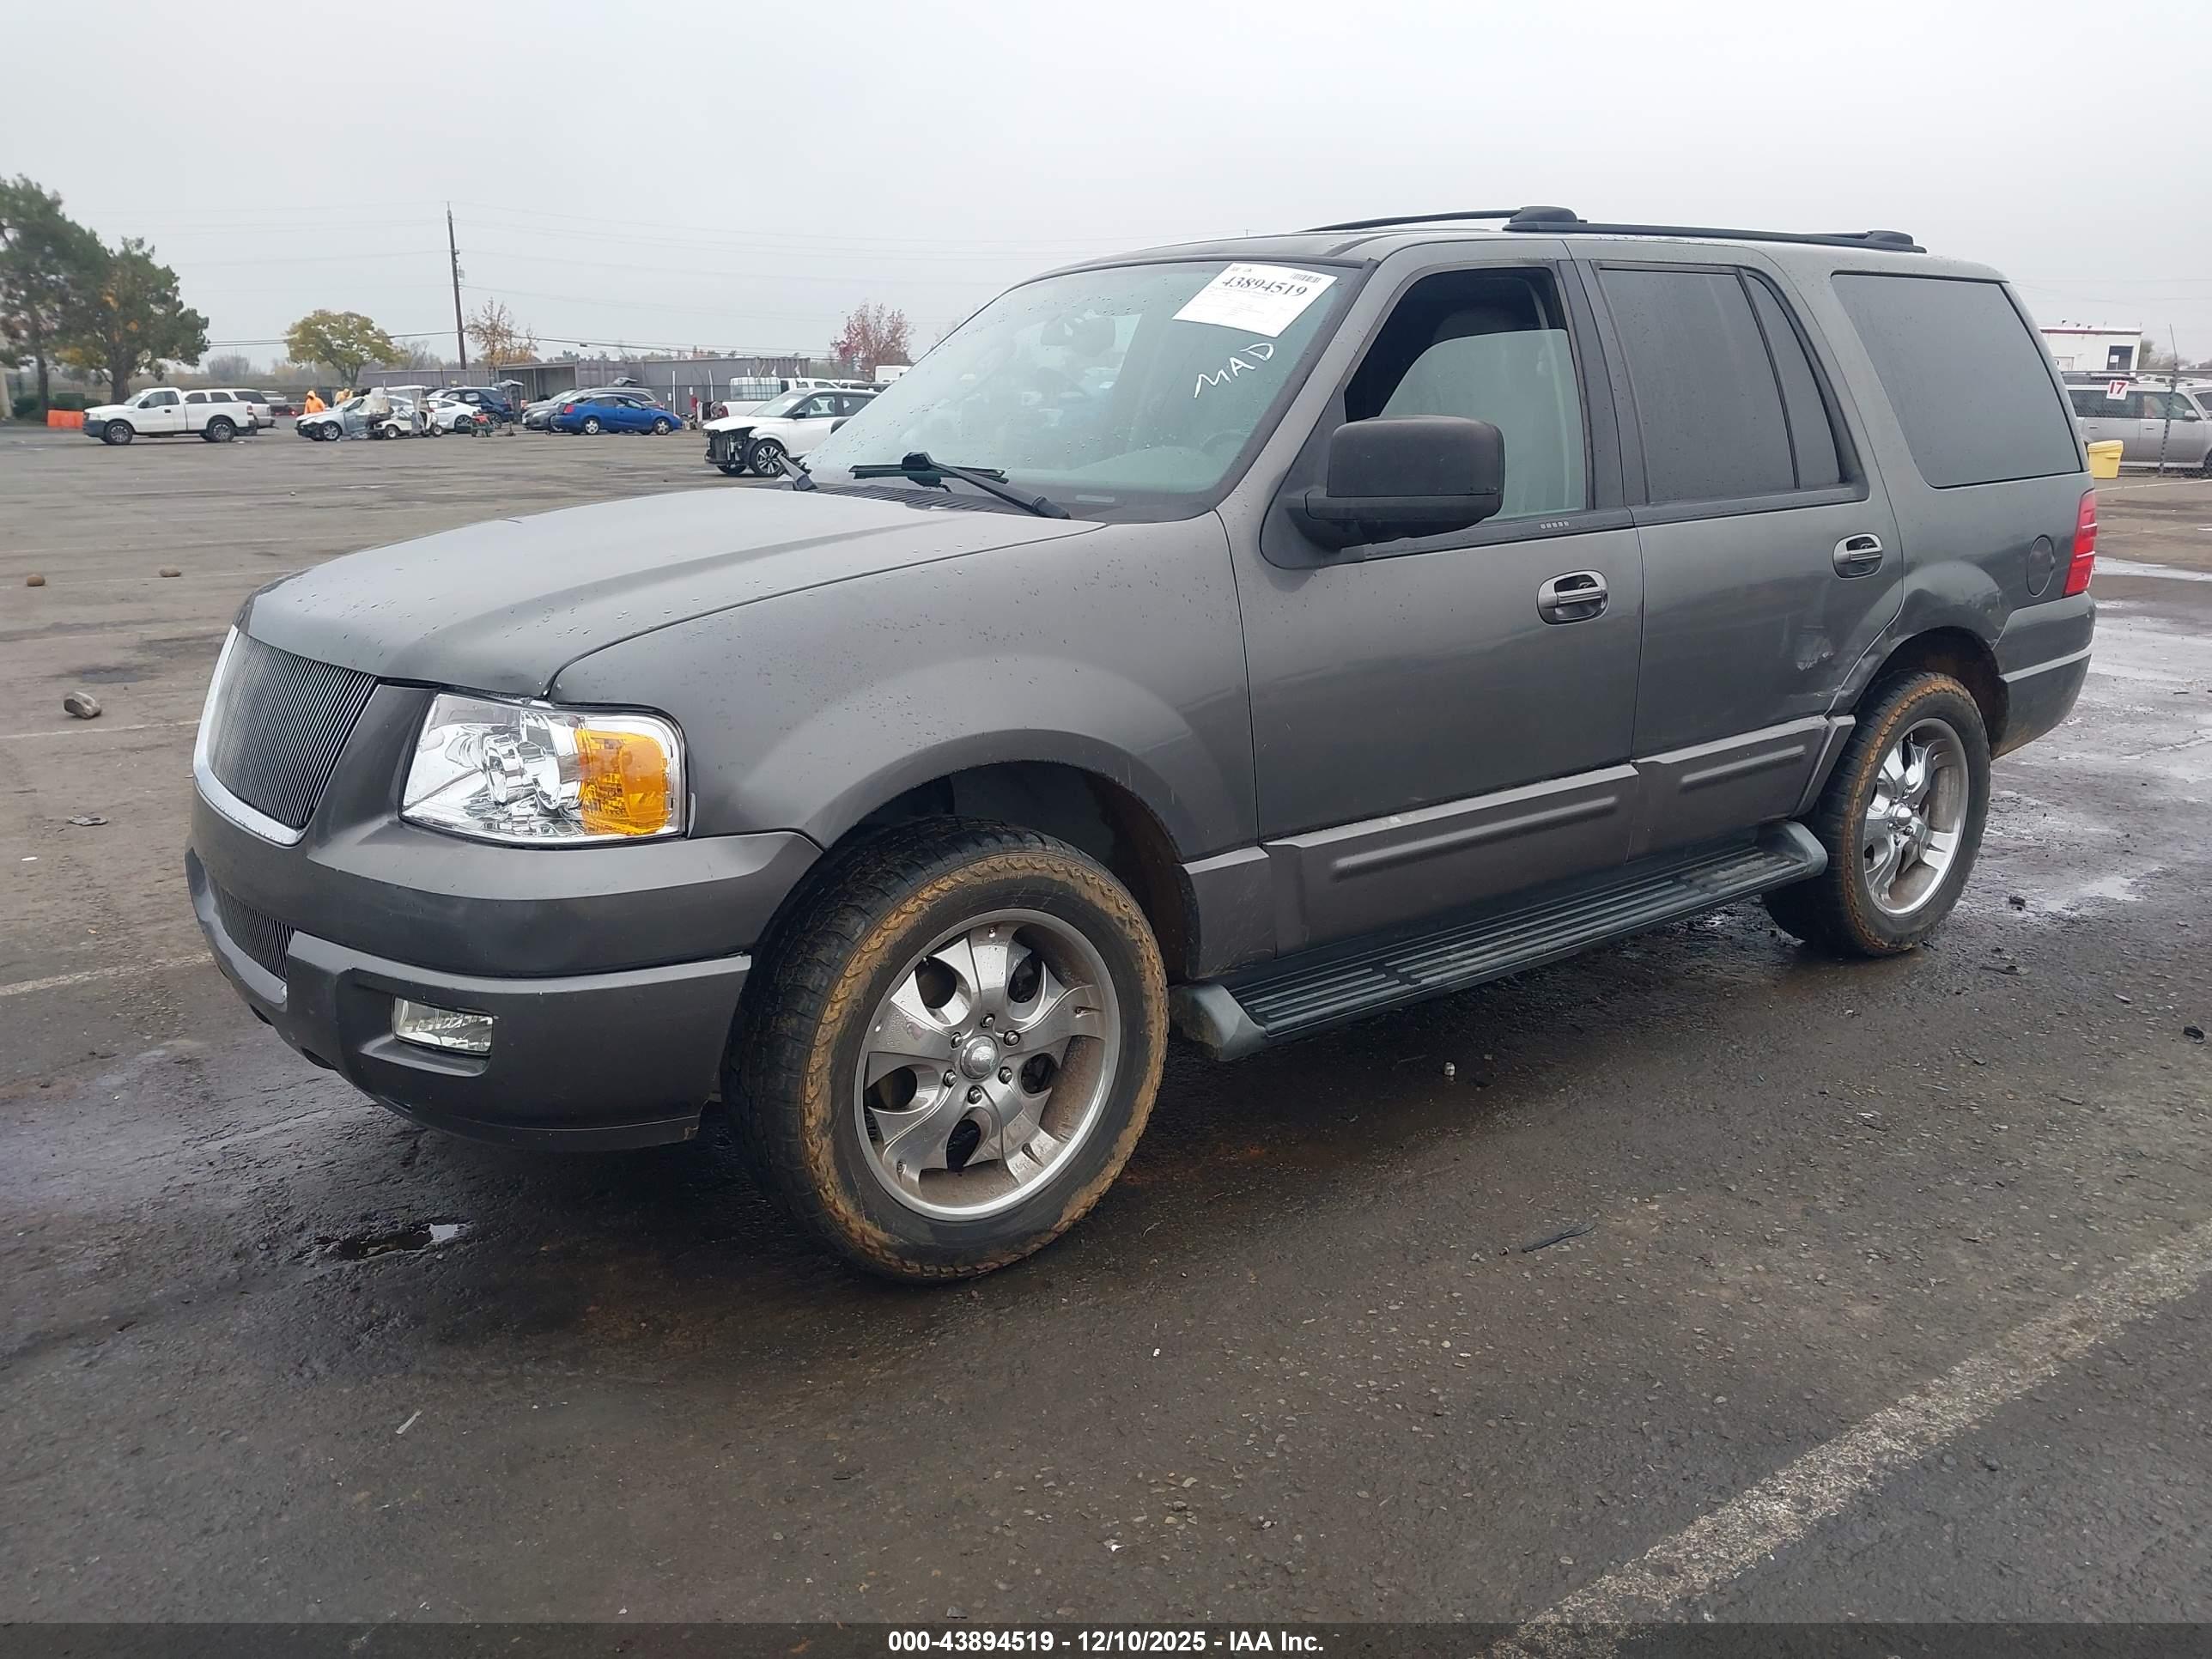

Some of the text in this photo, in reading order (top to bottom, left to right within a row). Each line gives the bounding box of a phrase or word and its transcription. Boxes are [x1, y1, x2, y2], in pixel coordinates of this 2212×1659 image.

[1222, 276, 1308, 297] 43894519
[1193, 343, 1274, 398] MAD
[2109, 381, 2127, 394] 17
